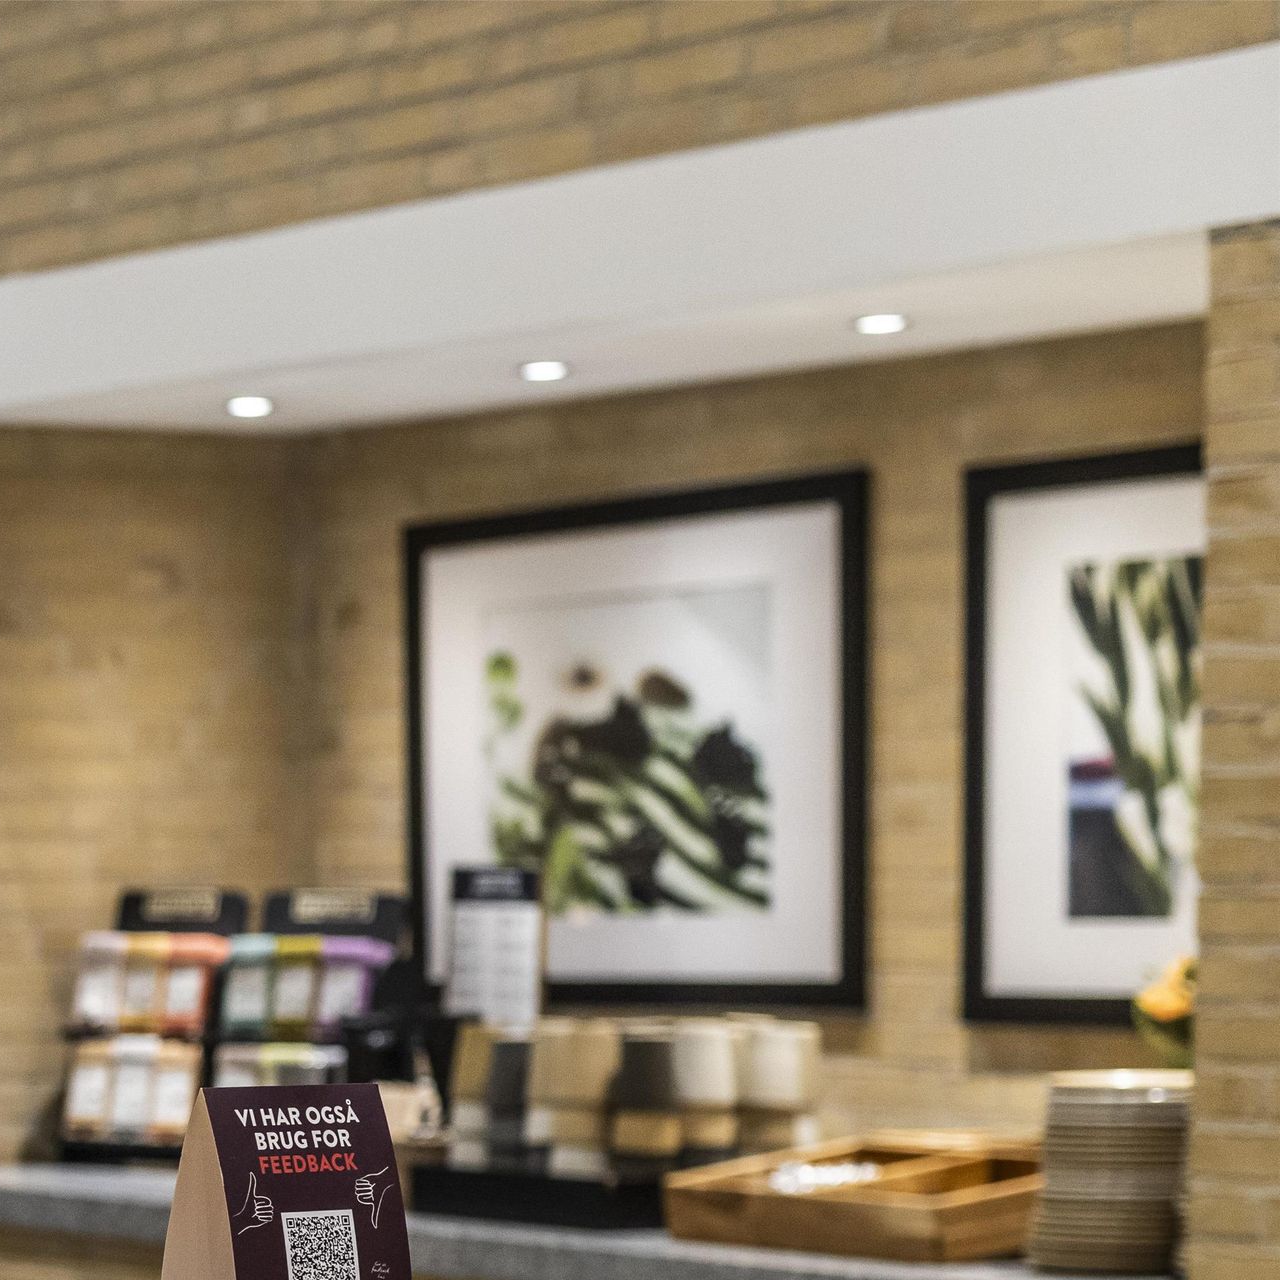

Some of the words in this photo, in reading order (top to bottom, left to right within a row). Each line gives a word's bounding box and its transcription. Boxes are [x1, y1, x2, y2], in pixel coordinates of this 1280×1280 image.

[234, 1108, 256, 1127] VI
[260, 1107, 302, 1126] HAR
[305, 1098, 360, 1125] OGSÅ
[254, 1130, 308, 1150] BRUG
[311, 1129, 351, 1148] FOR
[258, 1152, 358, 1174] FEEDBACK
